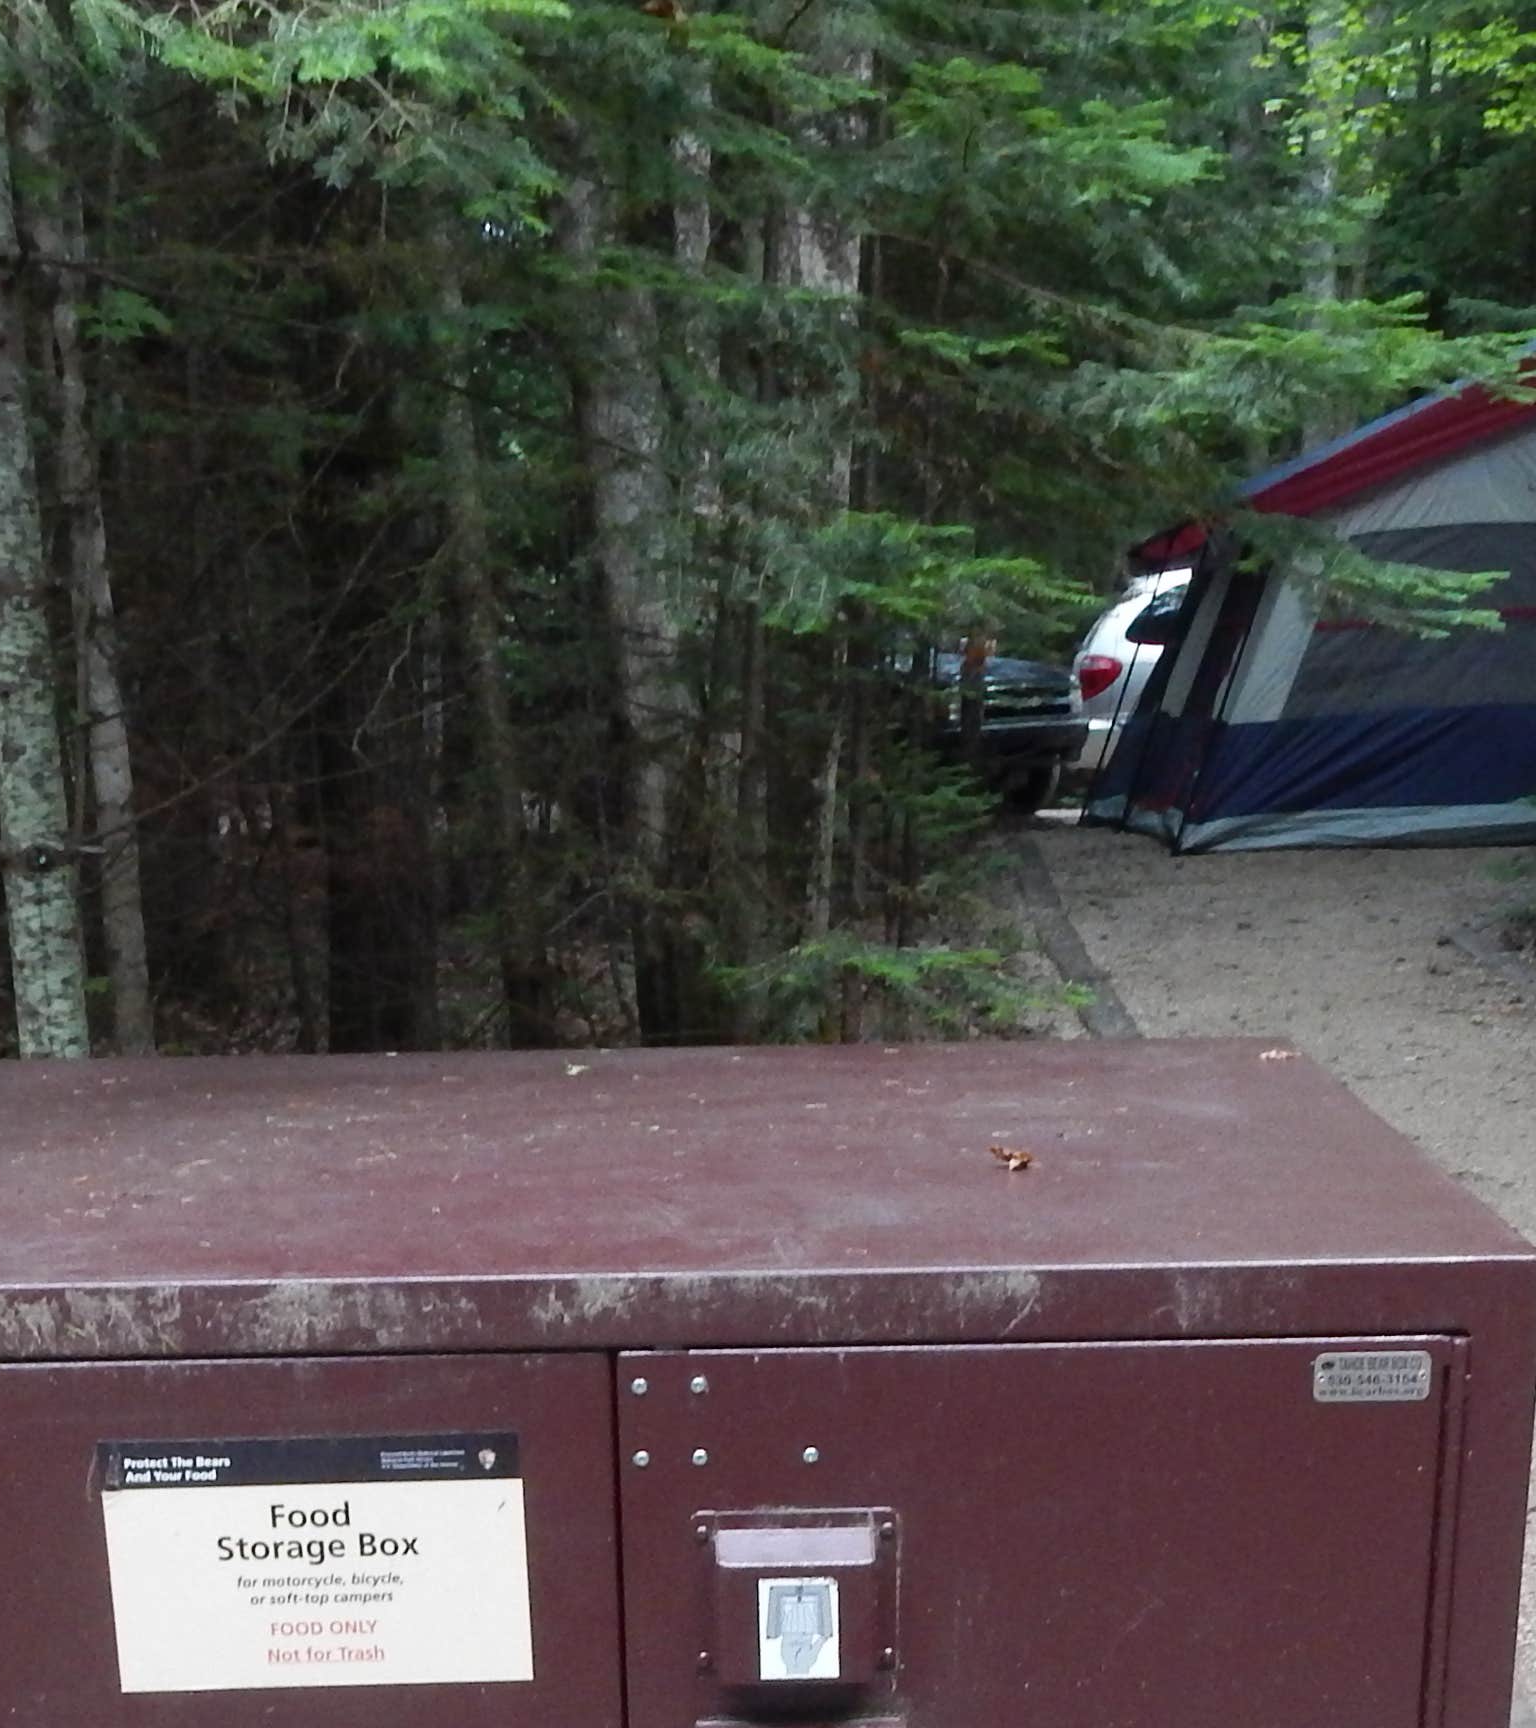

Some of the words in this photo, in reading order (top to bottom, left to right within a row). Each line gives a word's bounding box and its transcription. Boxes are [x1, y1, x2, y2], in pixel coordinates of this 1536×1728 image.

[124, 1457, 168, 1469] Protect
[171, 1456, 193, 1468] The
[196, 1455, 231, 1468] Bears
[125, 1470, 151, 1483] And
[153, 1470, 182, 1482] Your
[185, 1468, 217, 1481] Food
[270, 1501, 351, 1528] Food
[216, 1535, 346, 1565] Storage
[358, 1532, 419, 1557] Box
[236, 1576, 258, 1588] for
[262, 1573, 346, 1589] motorcycle,
[351, 1571, 404, 1587] bicycle,
[250, 1595, 265, 1605] or
[270, 1592, 329, 1606] soft-top
[334, 1591, 394, 1605] campers
[270, 1622, 323, 1636] FOOD
[329, 1620, 377, 1634] ONLY
[267, 1648, 300, 1662] Not
[306, 1645, 332, 1661] for
[338, 1644, 385, 1661] Trash
